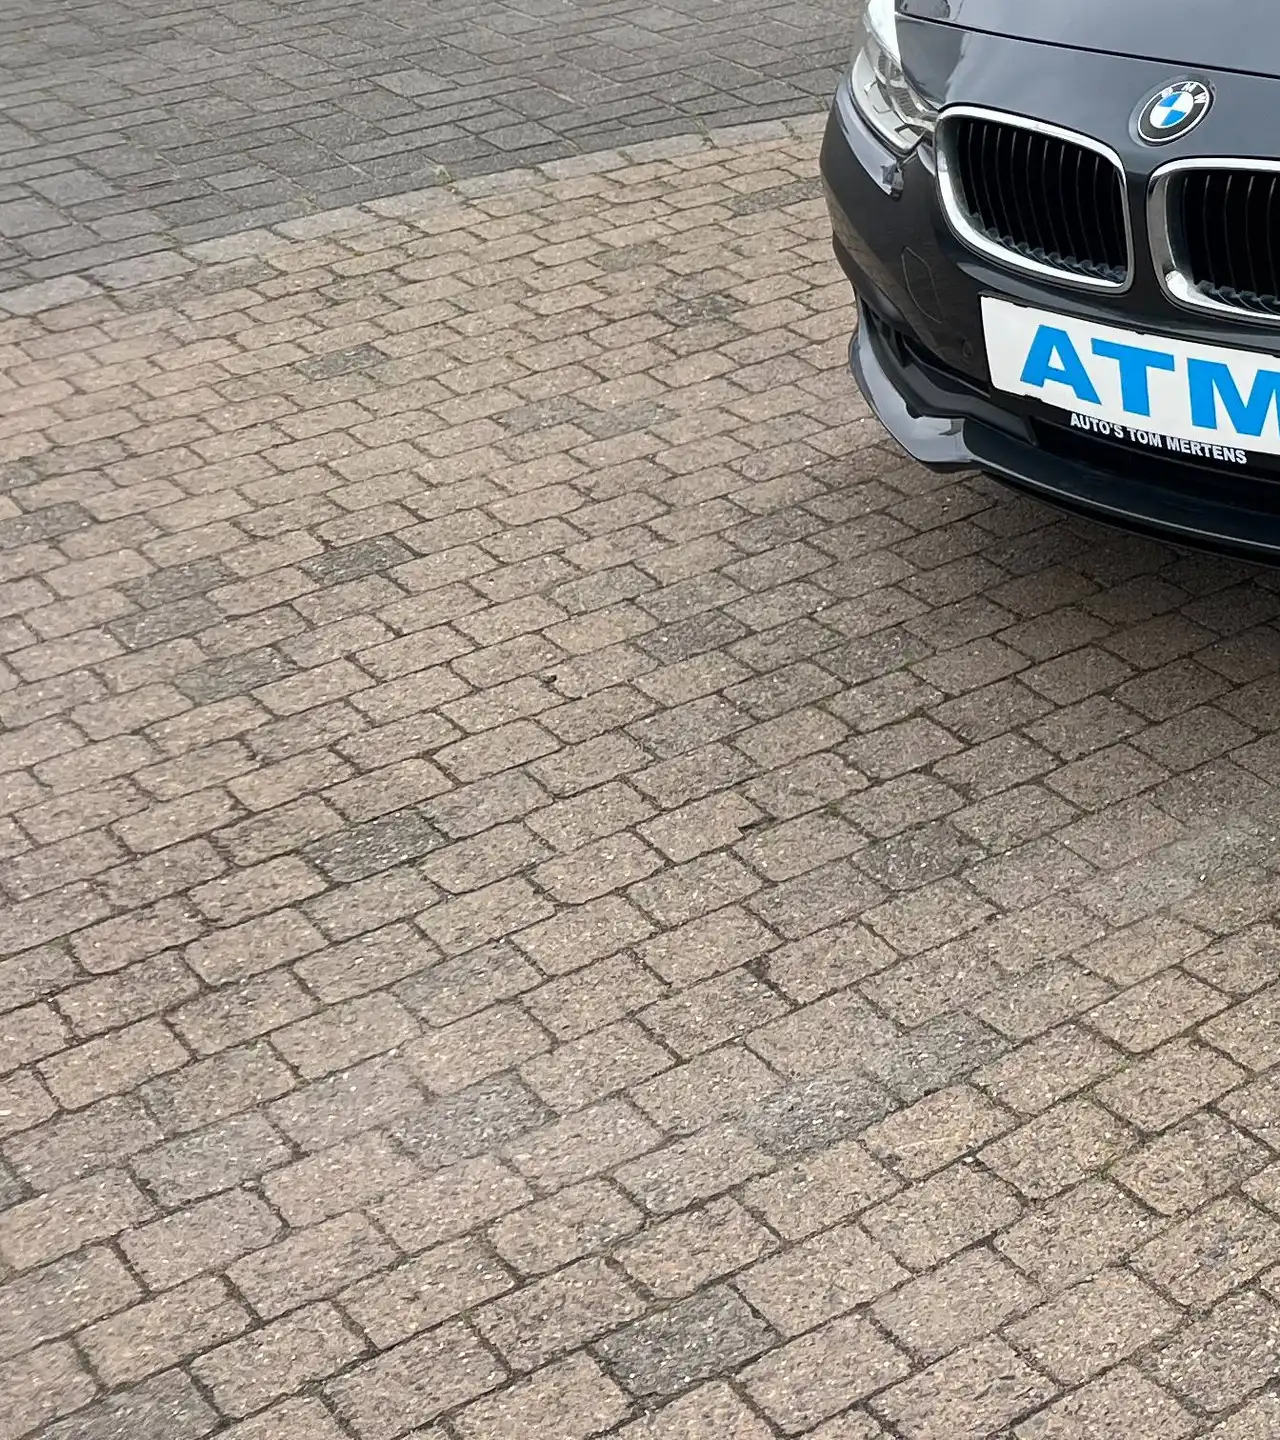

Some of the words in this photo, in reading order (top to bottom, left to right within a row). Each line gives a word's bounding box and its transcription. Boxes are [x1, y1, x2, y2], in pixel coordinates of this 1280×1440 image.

[1070, 413, 1124, 438] AUTO'S
[1127, 427, 1162, 448] TOM
[1166, 436, 1247, 464] MERTENS
